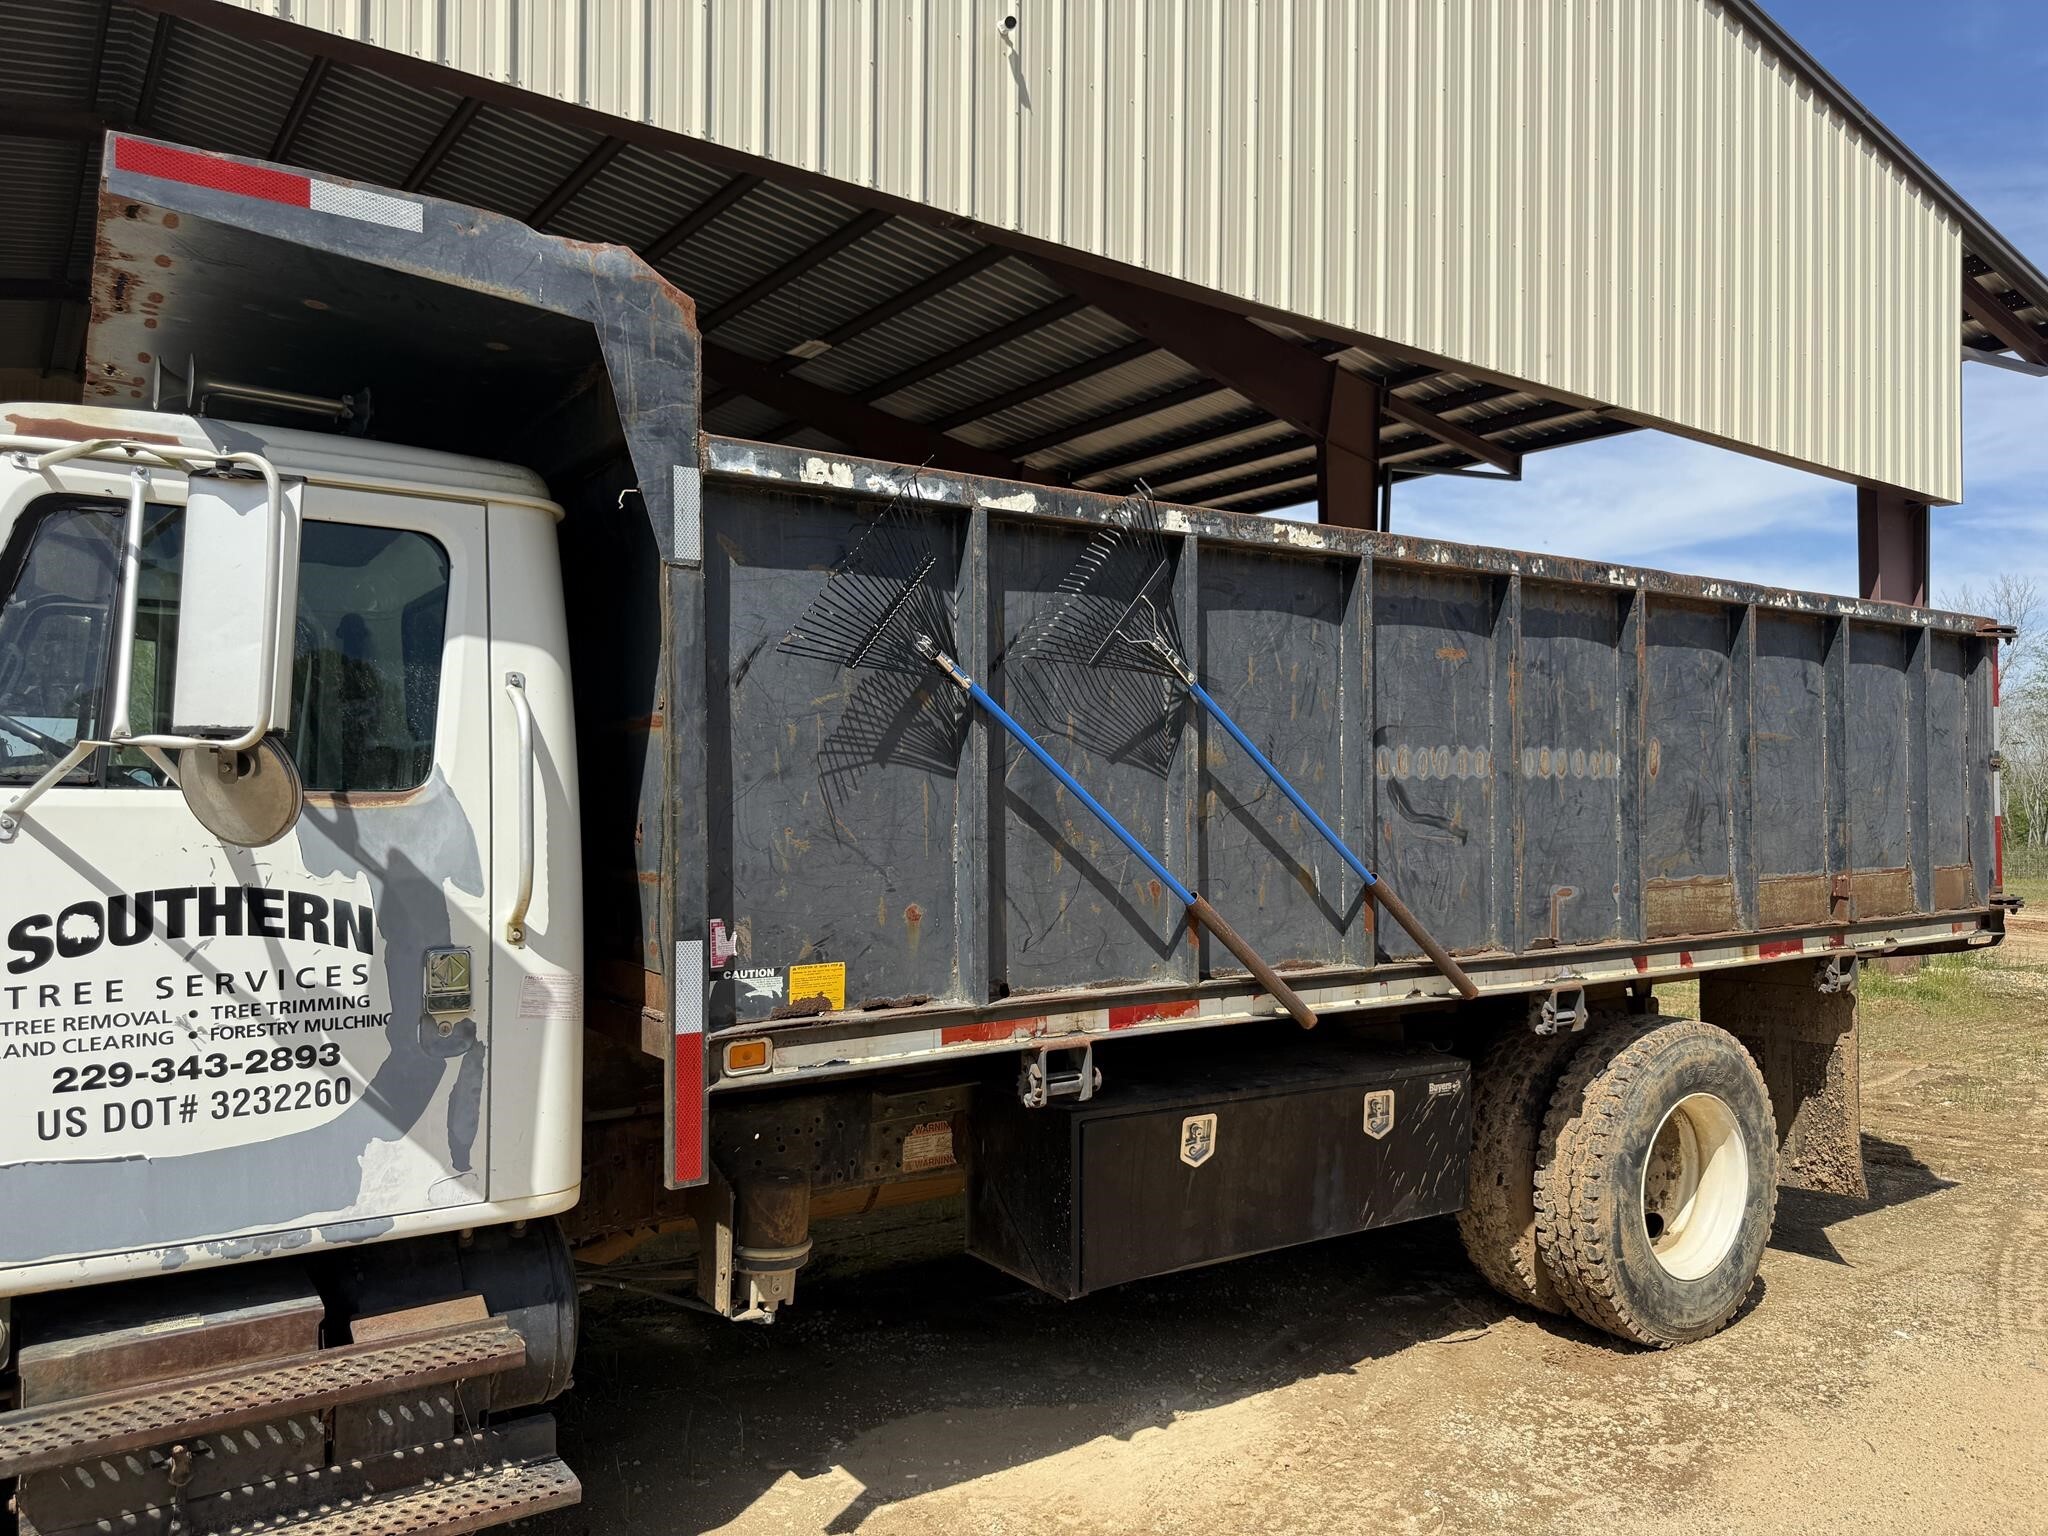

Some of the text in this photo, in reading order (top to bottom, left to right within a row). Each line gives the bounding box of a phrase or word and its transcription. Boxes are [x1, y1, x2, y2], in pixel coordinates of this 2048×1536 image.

[7, 886, 374, 974] SOUTHERN
[4, 963, 369, 1010] TREE SERVICES
[723, 968, 774, 980] CAUTION
[0, 994, 371, 1037] TREE REMOVAL TREE TRIMMING
[0, 1040, 56, 1060] AND
[62, 1030, 174, 1054] CLEARING
[210, 1019, 301, 1042] FORESTRY
[52, 1042, 341, 1094] 229-343-2893
[37, 1076, 351, 1141] US DOT# 3232260
[914, 1121, 950, 1136] WARNIN
